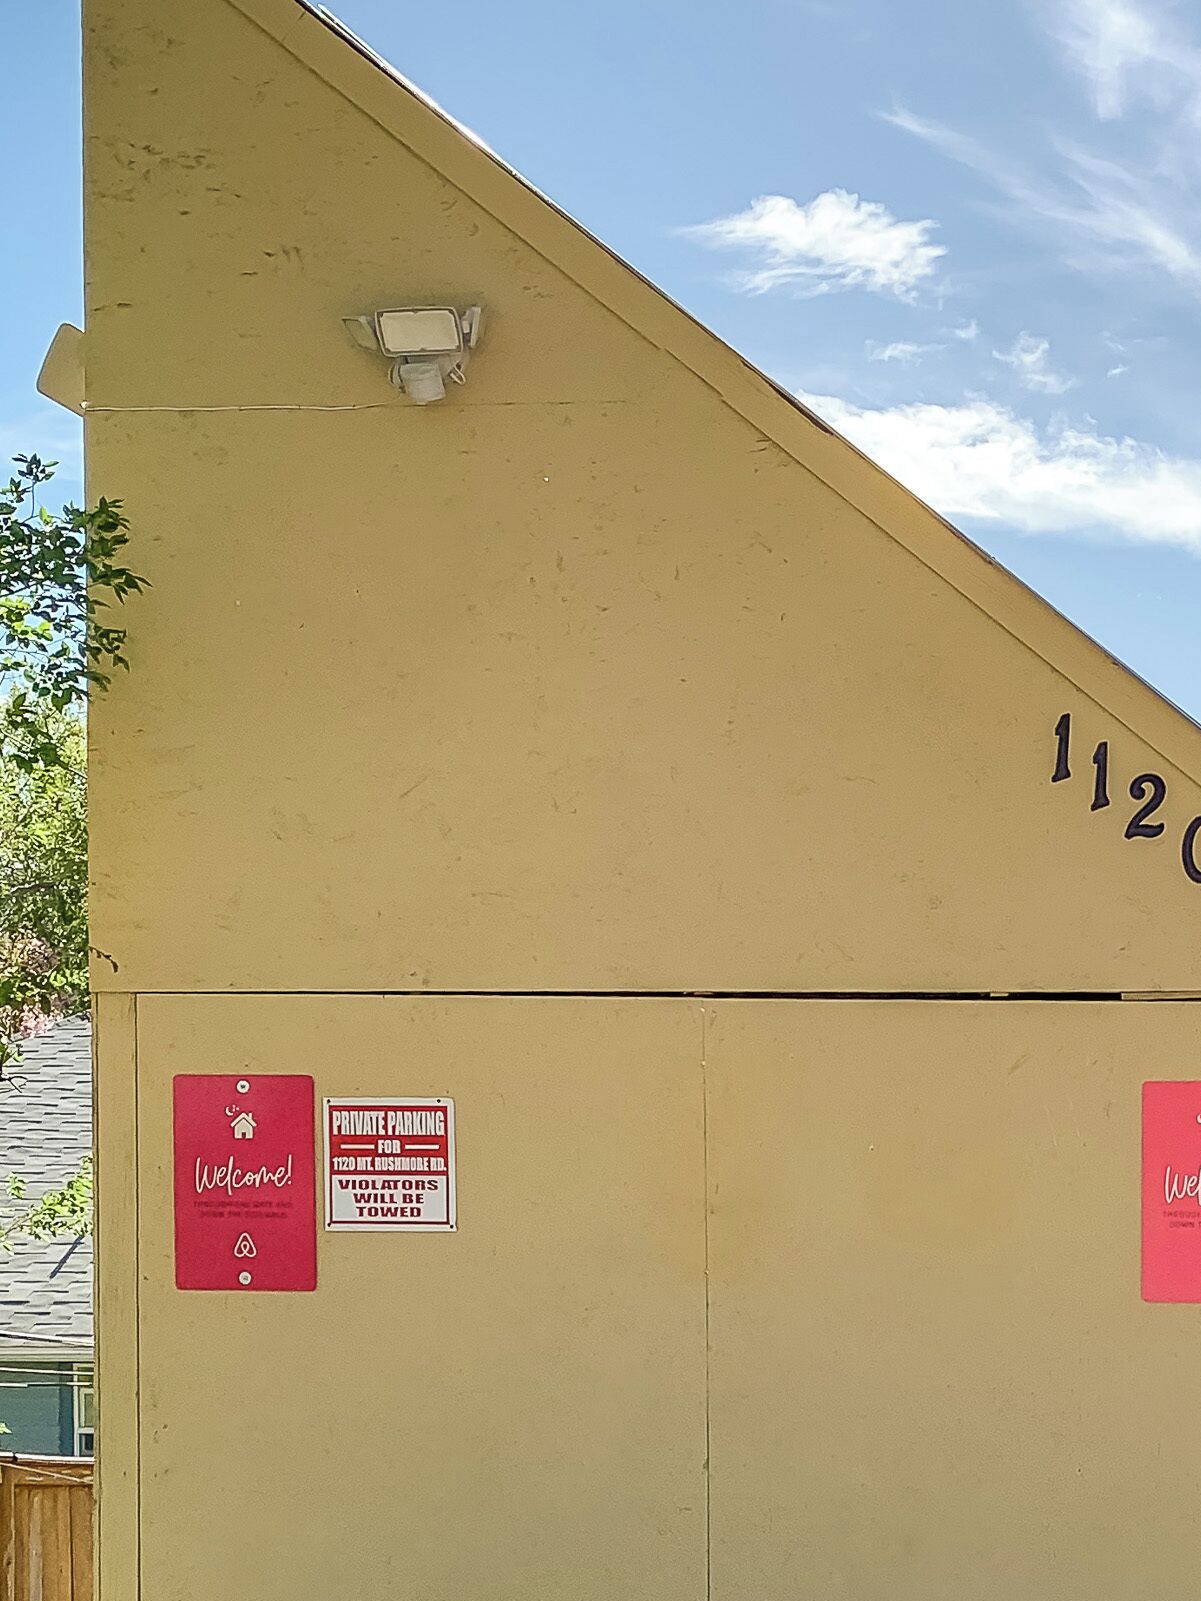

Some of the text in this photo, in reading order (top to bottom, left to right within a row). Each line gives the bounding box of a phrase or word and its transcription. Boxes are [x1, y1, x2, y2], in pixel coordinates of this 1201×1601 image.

[332, 1110, 445, 1136] PRIVATE PARKING
[377, 1139, 401, 1154] FOR
[332, 1157, 447, 1171] 1120 MT. RUSHMORE RD.
[195, 1154, 292, 1196] Welcome!
[338, 1180, 438, 1190] VIOLATORS
[353, 1193, 424, 1204] WILL BE
[356, 1206, 421, 1218] TOWED
